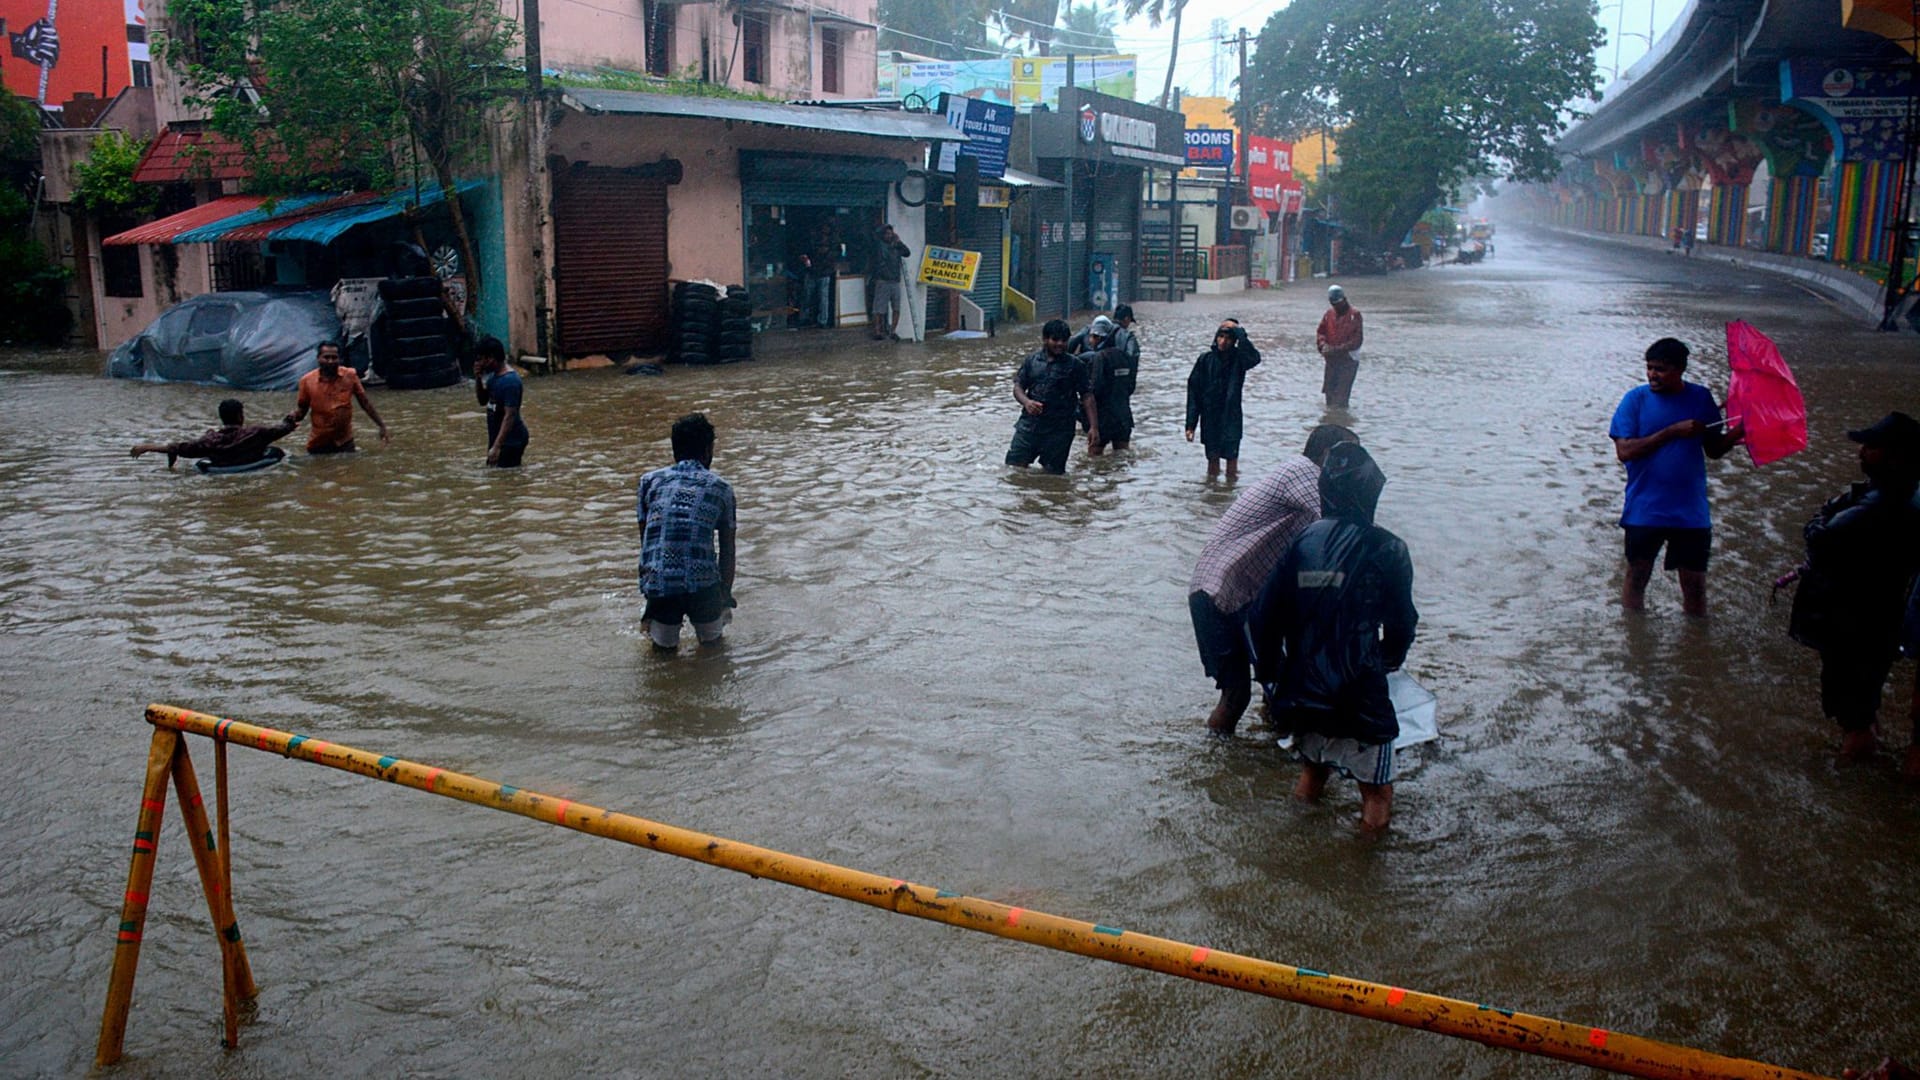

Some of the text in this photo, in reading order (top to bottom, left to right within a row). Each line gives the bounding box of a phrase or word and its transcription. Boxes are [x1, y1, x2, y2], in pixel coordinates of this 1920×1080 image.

[984, 108, 997, 121] AR
[964, 120, 983, 131] TOURS
[988, 124, 1011, 135] TRAVELS
[1184, 132, 1231, 145] ROOMS
[1187, 146, 1222, 159] BAR
[932, 261, 967, 272] MONEY
[924, 267, 970, 281] CHANGER
